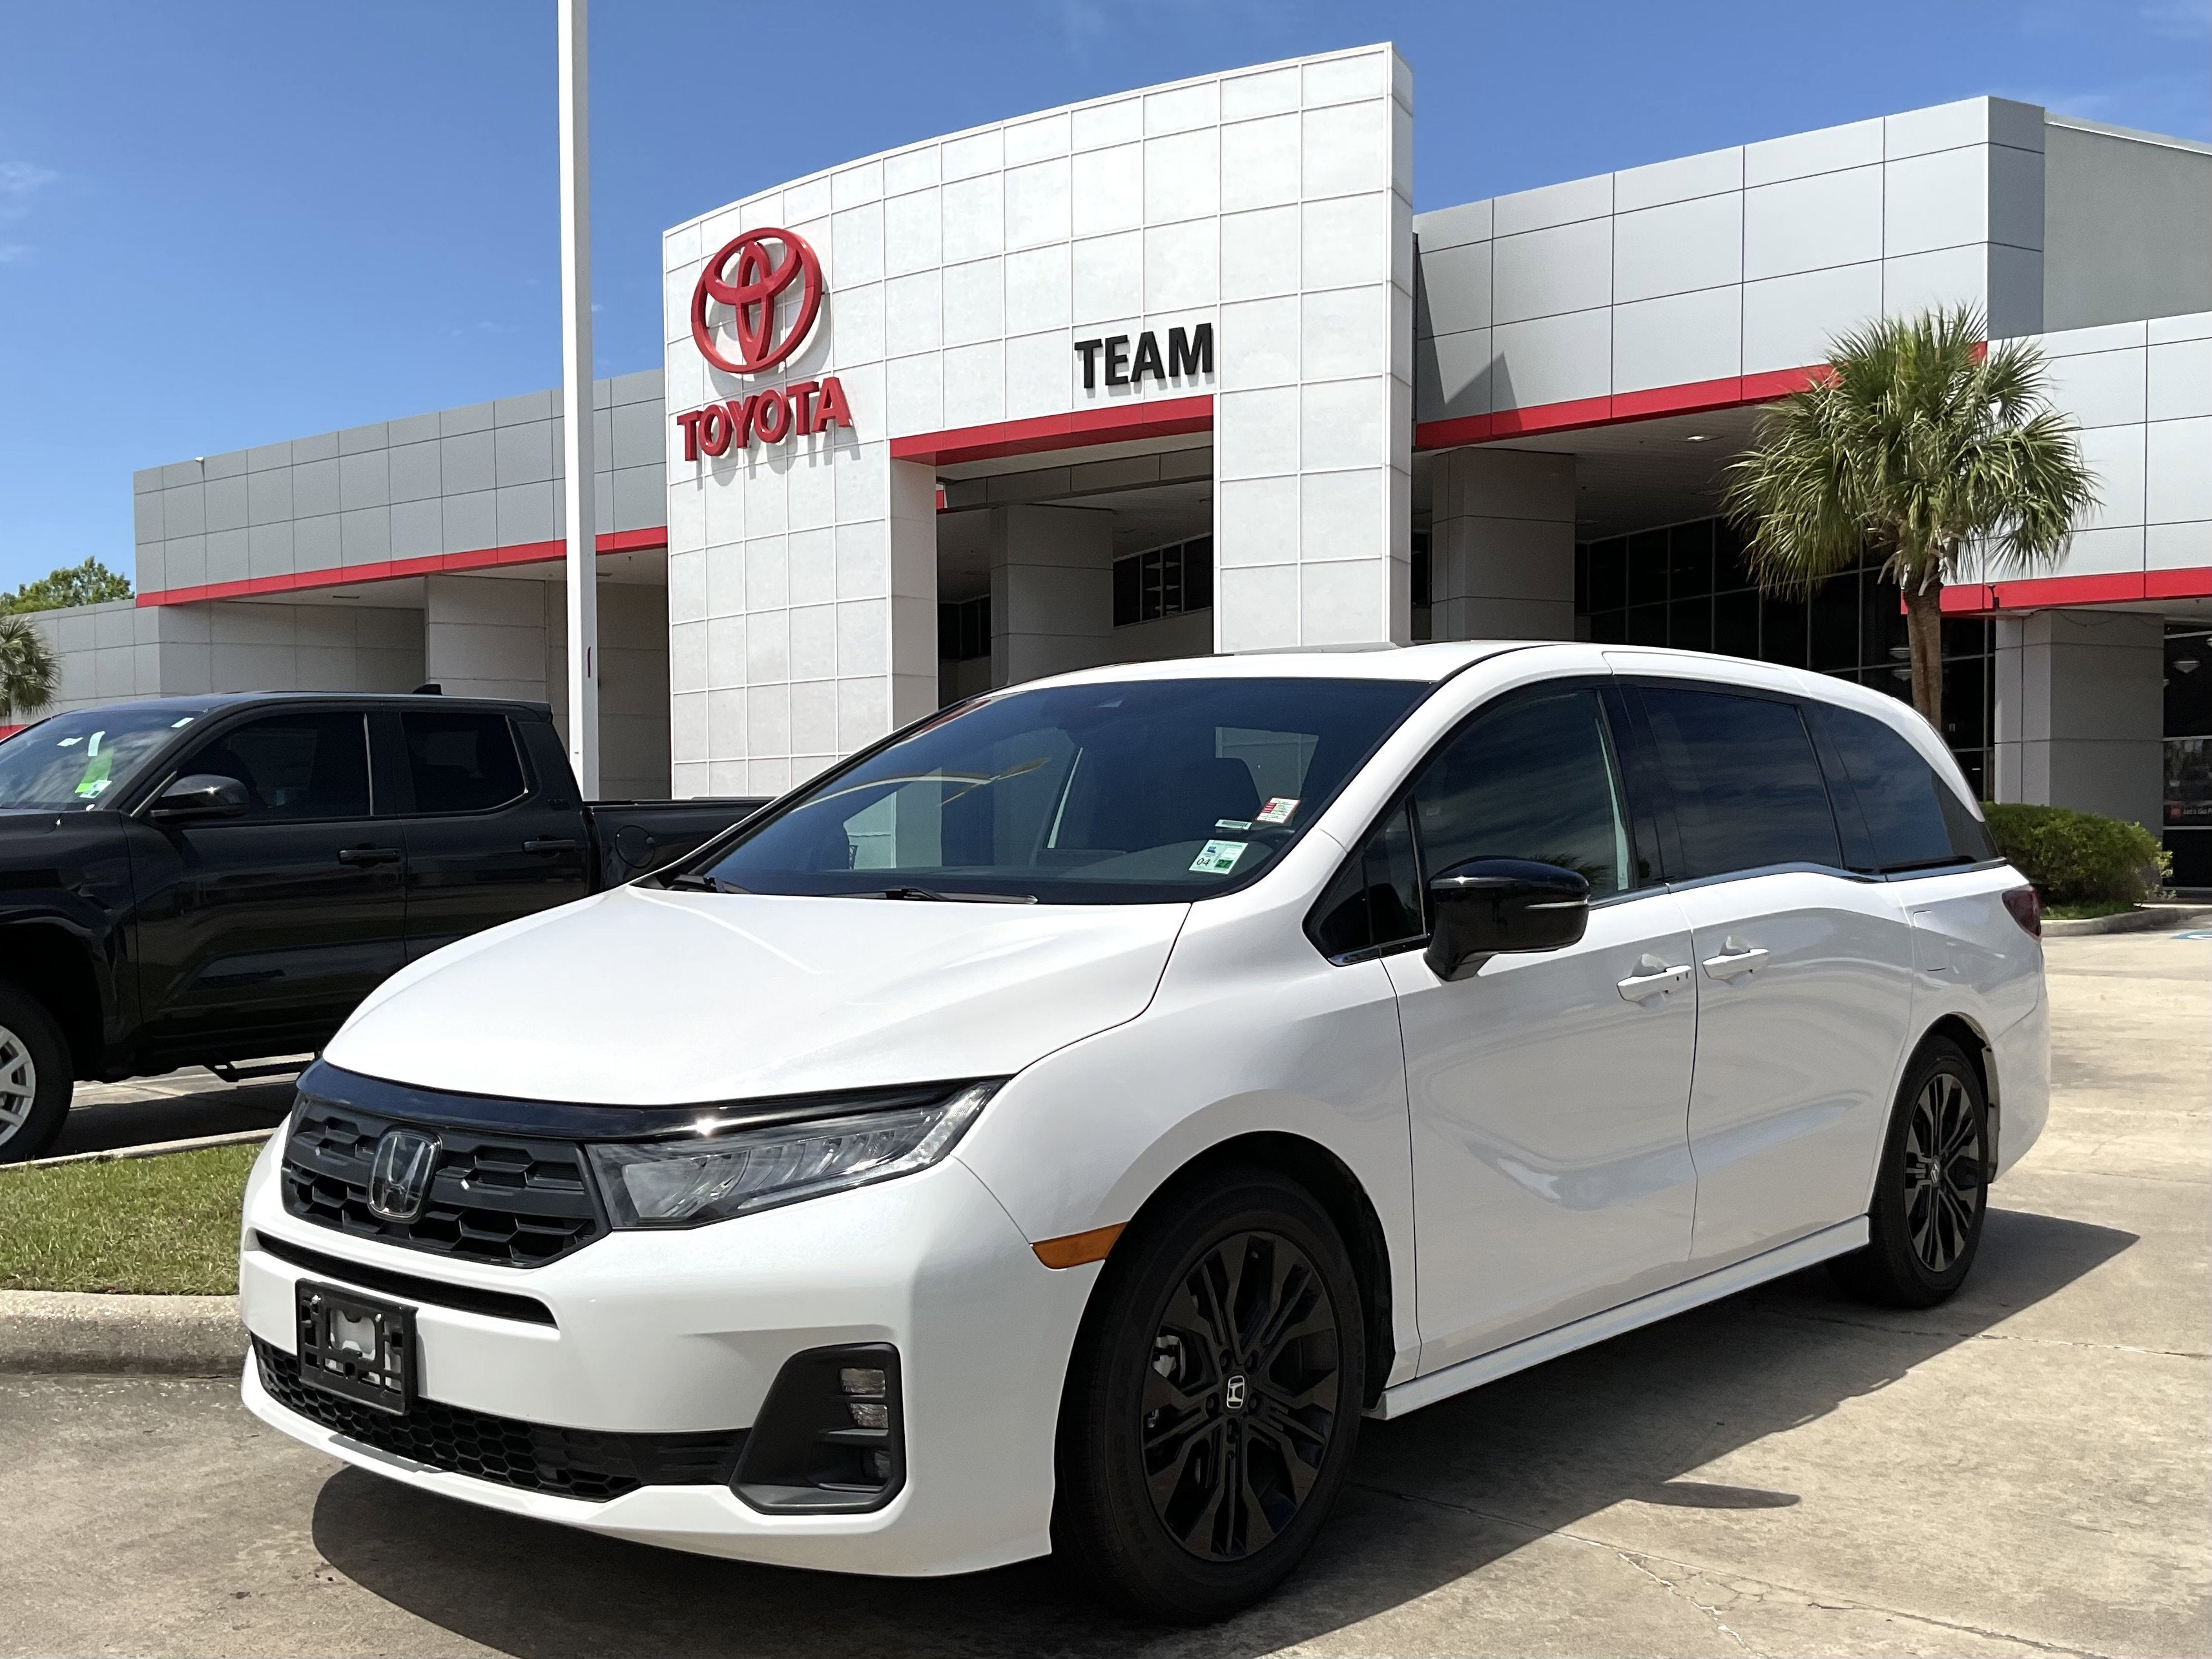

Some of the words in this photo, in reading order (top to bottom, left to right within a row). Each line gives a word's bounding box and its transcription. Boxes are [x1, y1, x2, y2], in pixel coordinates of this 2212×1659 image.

[1075, 323, 1212, 389] TEAM
[676, 376, 853, 461] TOYOTA
[1197, 858, 1211, 867] 04
[1215, 859, 1232, 868] 27
